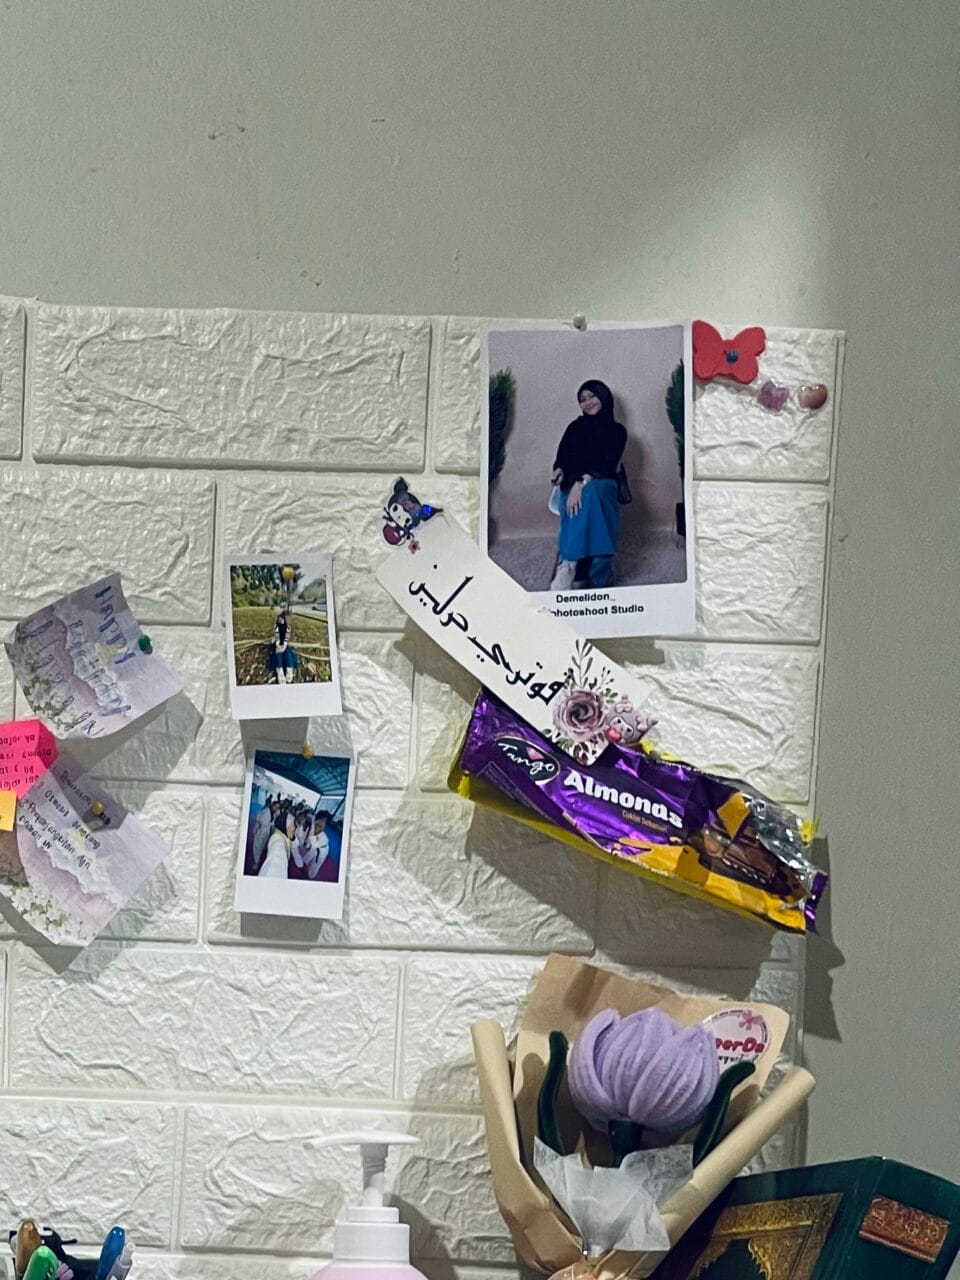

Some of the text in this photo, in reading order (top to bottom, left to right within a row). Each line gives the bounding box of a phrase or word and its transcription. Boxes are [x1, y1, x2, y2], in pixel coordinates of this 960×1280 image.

[94, 585, 136, 665] HAPPY
[610, 603, 645, 614] Studio
[498, 743, 555, 775] Tango
[564, 769, 684, 829] Almonds
